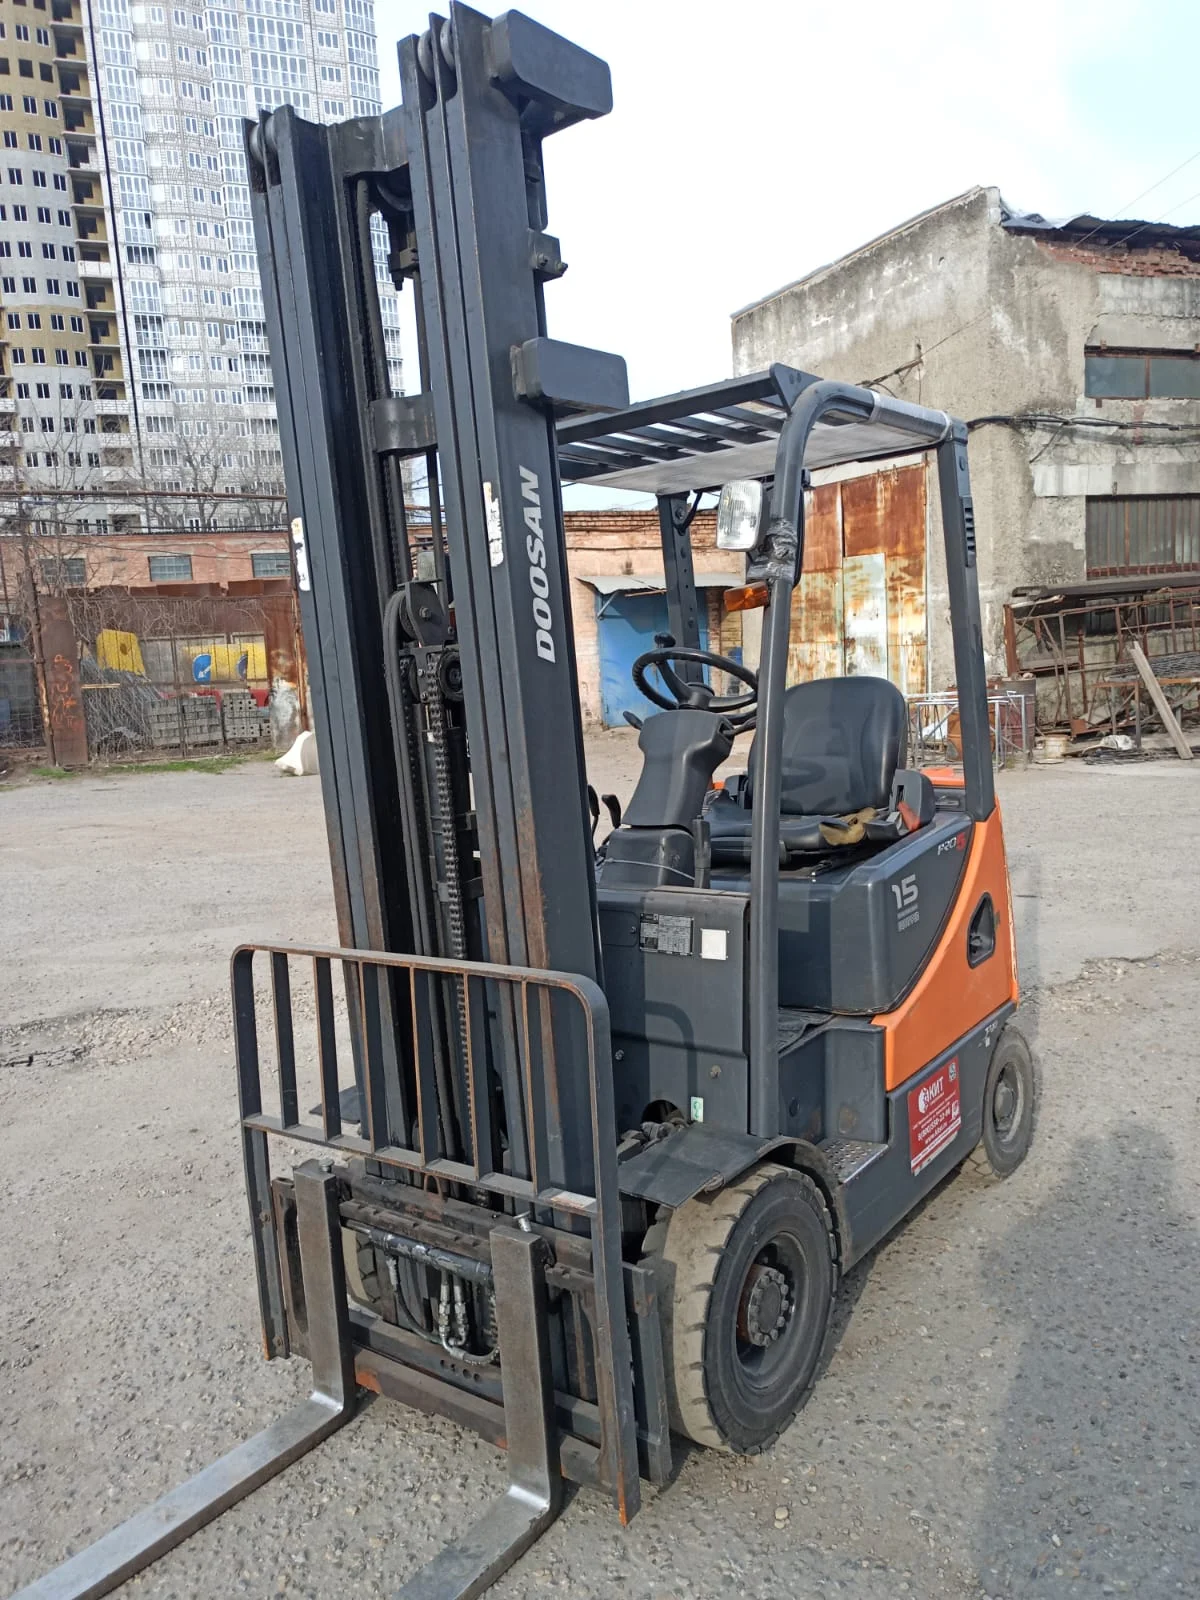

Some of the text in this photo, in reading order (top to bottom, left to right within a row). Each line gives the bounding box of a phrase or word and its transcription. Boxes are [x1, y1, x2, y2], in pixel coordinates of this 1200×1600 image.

[519, 465, 556, 664] DOOSAN
[891, 874, 919, 910] 15
[928, 1076, 944, 1101] КИТ
